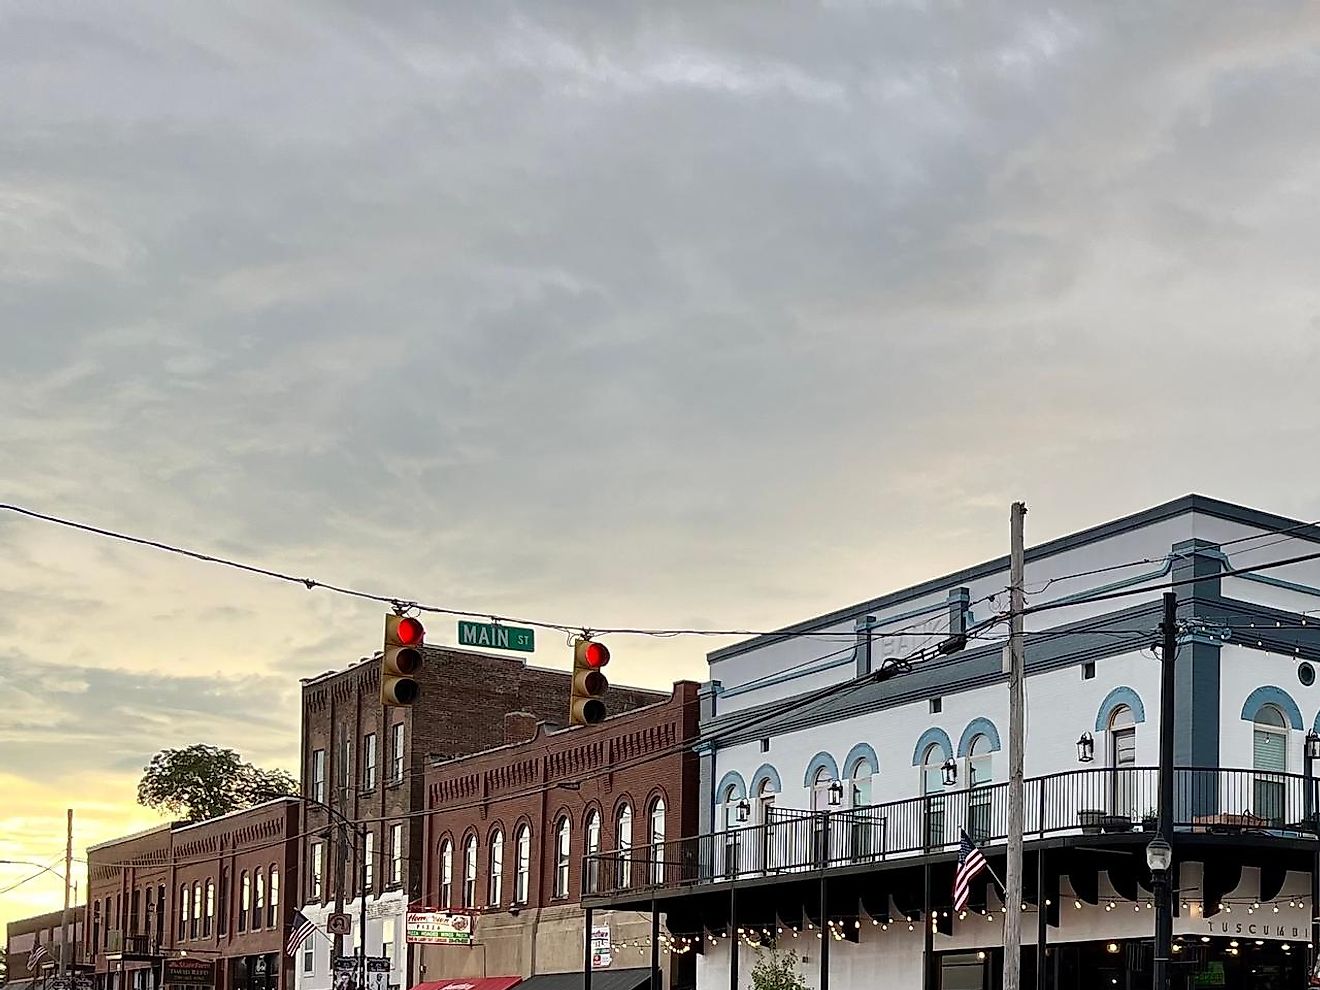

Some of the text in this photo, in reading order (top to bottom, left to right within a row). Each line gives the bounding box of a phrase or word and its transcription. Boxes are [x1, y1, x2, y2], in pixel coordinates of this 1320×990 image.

[463, 624, 529, 648] MAIN ST
[1207, 921, 1309, 938] TUSCUMBI
